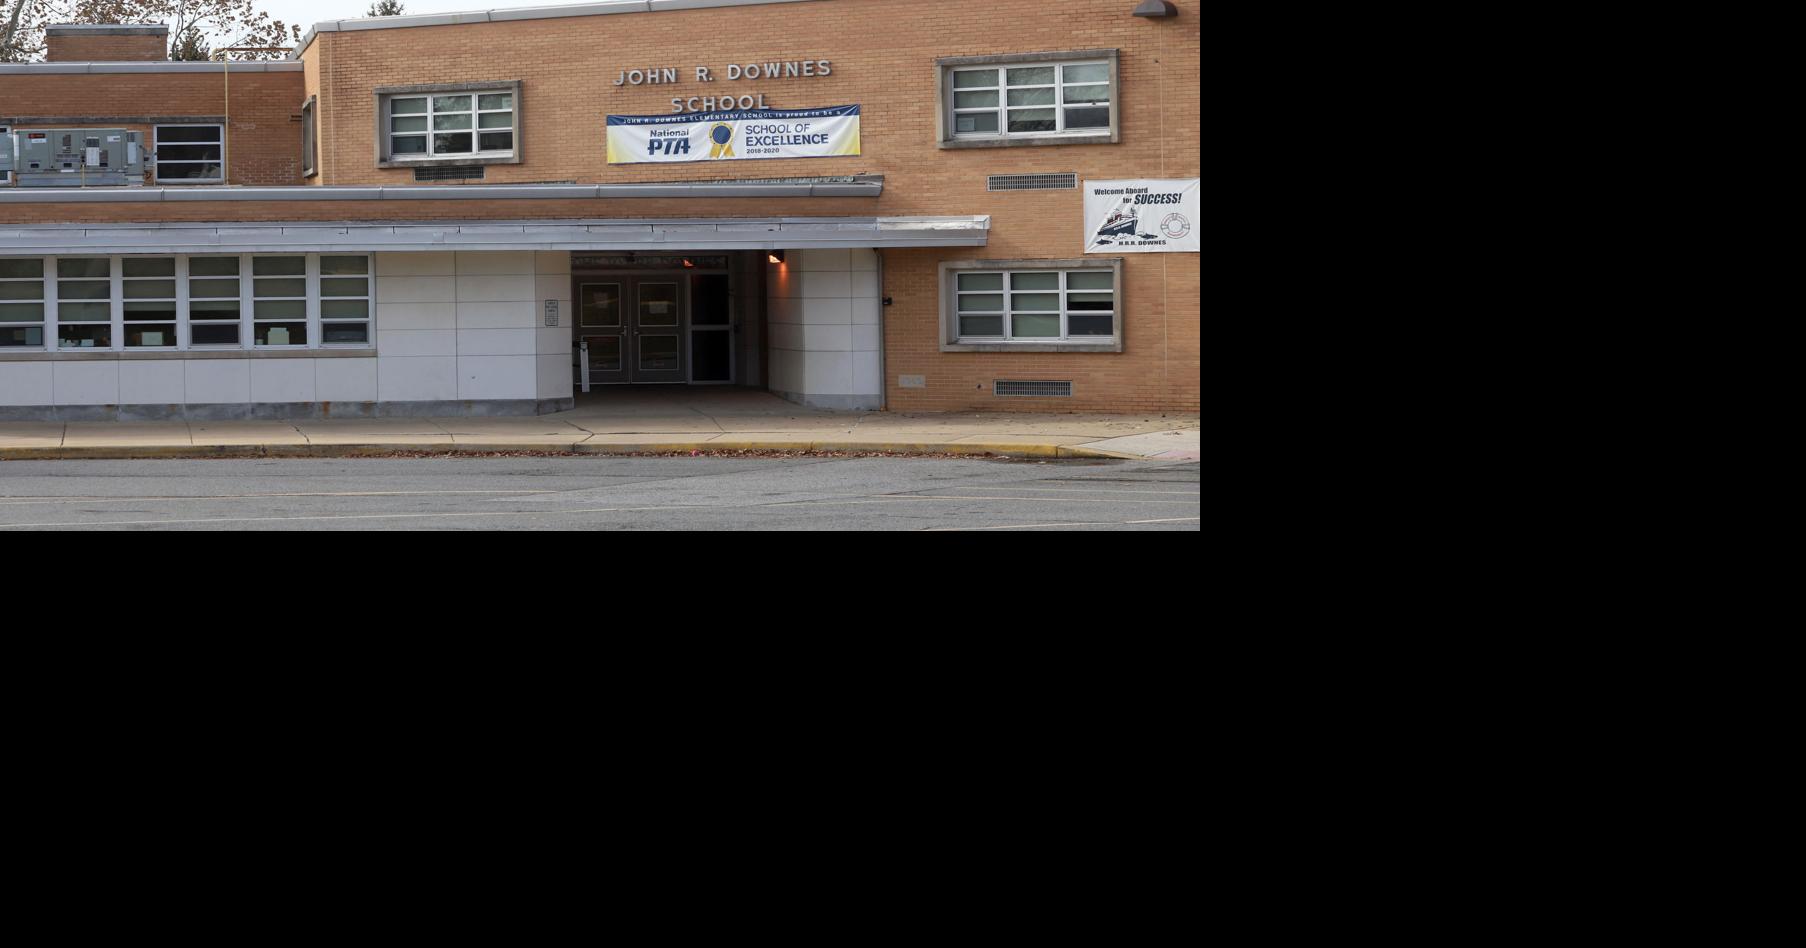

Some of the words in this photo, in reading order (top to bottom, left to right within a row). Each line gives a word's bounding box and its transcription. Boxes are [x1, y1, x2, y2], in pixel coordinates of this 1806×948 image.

[613, 67, 677, 86] JOHN
[696, 66, 713, 82] R.
[727, 59, 831, 80] DOWNES
[671, 94, 769, 113] SCHOOL
[689, 113, 739, 121] ELEMENTARY
[650, 129, 689, 138] National
[745, 124, 792, 135] SCHOOL
[794, 123, 811, 133] OF
[745, 133, 829, 147] EXCELLENCE
[647, 138, 691, 156] PTA
[1094, 188, 1124, 196] Welcome
[1125, 187, 1148, 195] Aboard
[1134, 193, 1182, 205] SUCCESS!
